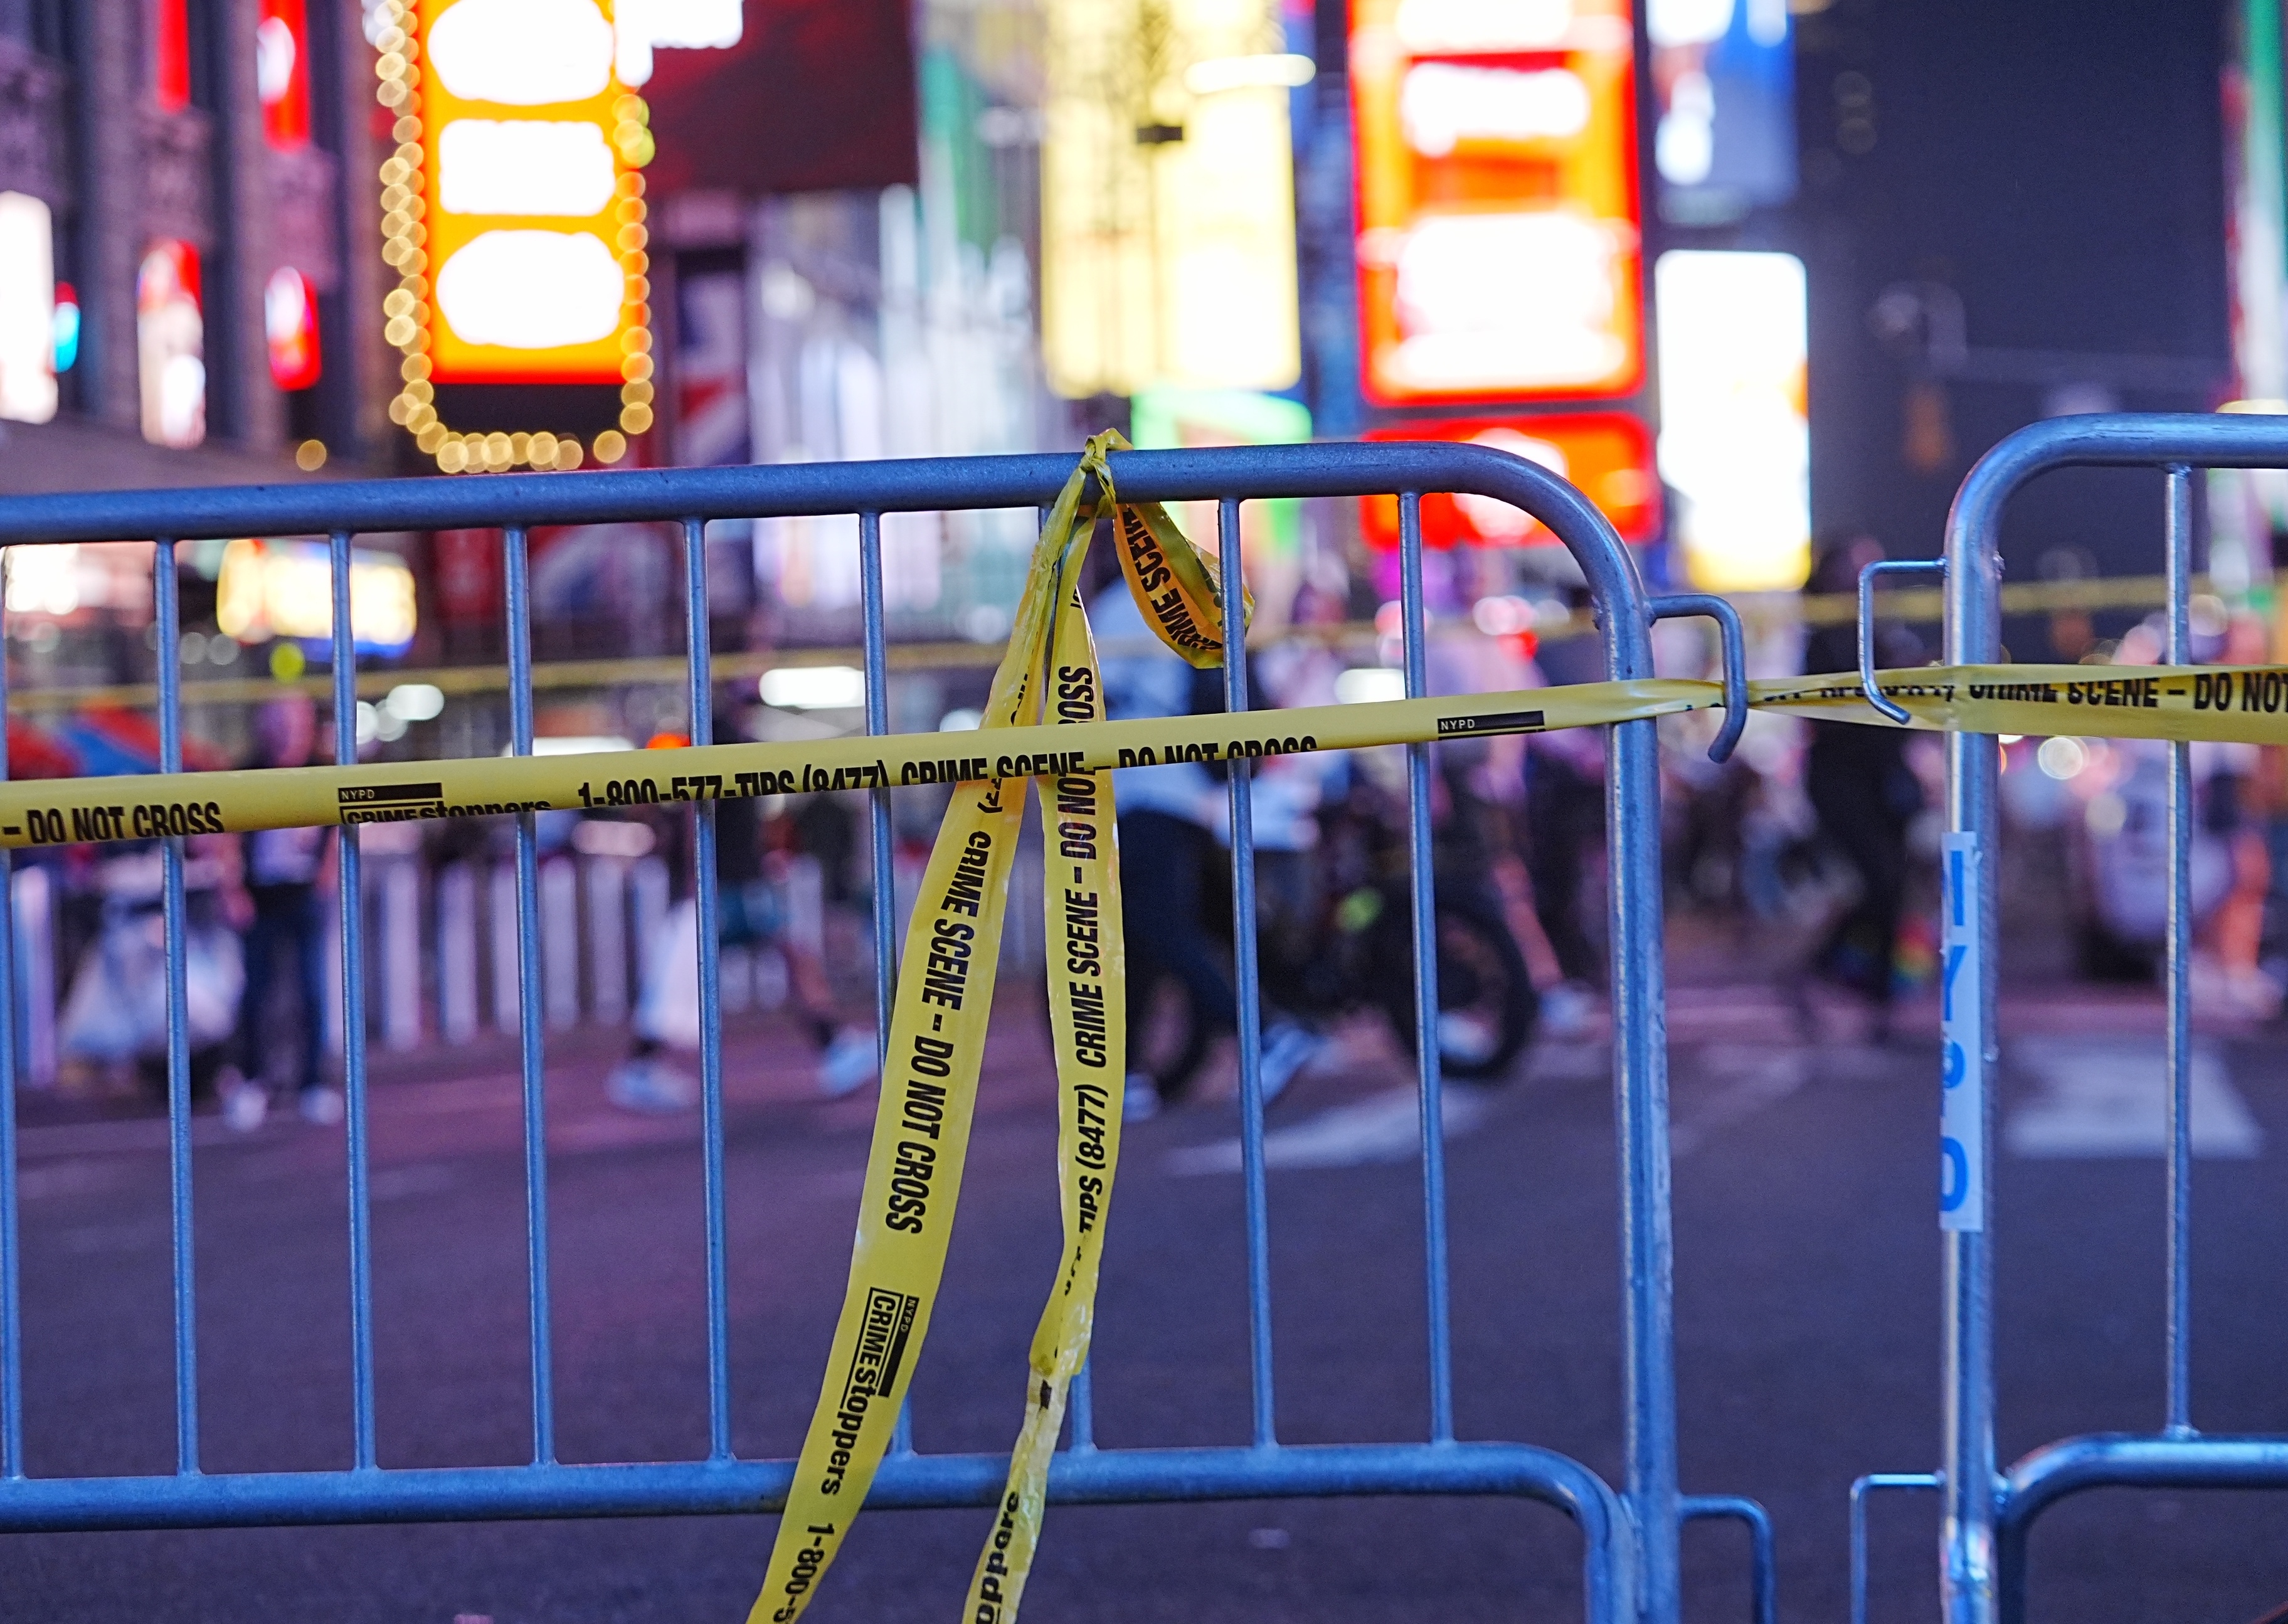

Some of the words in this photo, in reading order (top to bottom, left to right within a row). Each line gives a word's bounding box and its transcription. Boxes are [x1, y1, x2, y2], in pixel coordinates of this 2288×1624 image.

[1122, 507, 1171, 592] SCEN
[1057, 666, 1094, 724] OSS
[2068, 677, 2161, 708] SCENE
[2194, 672, 2232, 711] DO
[1440, 718, 1475, 731] NYPD
[341, 788, 375, 800] NYPD
[803, 759, 889, 792] (8477)
[901, 758, 988, 786] CRIME
[996, 751, 1085, 778] SCENE
[1057, 776, 1096, 815] NO
[26, 808, 67, 844] DO
[72, 806, 125, 842] NOT
[132, 801, 225, 838] CROSS
[1057, 822, 1097, 860] DO
[941, 831, 991, 917] CRIME
[1065, 888, 1101, 977] SCENE
[921, 918, 974, 1011] SCENE
[1069, 981, 1106, 1068] CRIME
[911, 1035, 954, 1077] DO
[902, 1080, 946, 1140] NOT
[1074, 1084, 1108, 1169] (8477)
[885, 1141, 936, 1234] CROSS
[901, 1298, 916, 1333] NYPD
[820, 1295, 896, 1495] CRIMEstoppers
